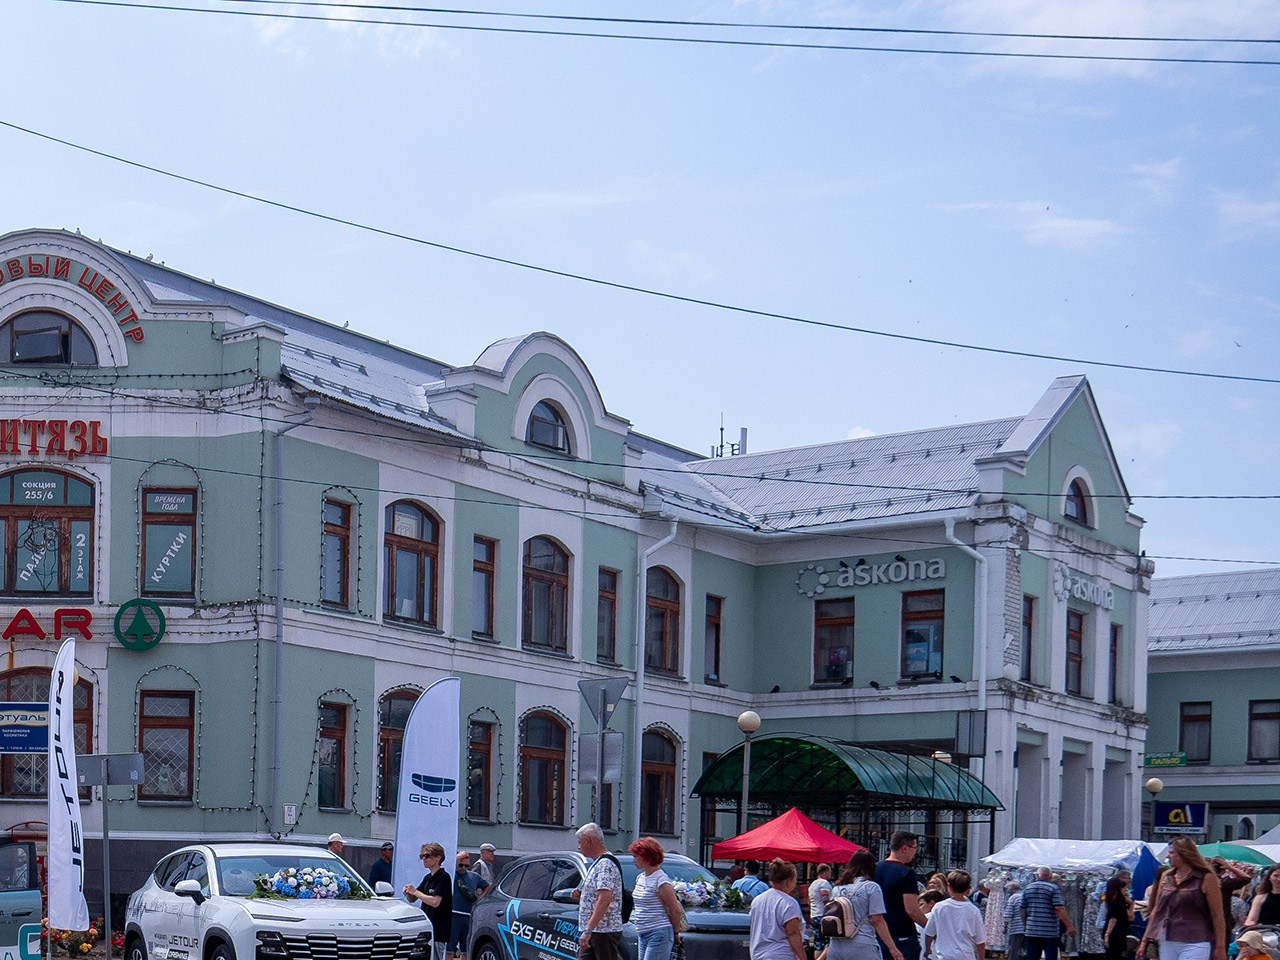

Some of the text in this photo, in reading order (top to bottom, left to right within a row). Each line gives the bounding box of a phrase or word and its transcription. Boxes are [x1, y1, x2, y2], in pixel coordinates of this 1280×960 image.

[77, 267, 145, 343] ЦЕНТР
[25, 491, 54, 500] 255/6
[161, 503, 178, 511] ГОДА
[76, 533, 86, 547] 2
[151, 532, 187, 582] КУРТКИ
[836, 557, 946, 588] askona
[1072, 575, 1115, 610] askona
[54, 671, 83, 893] JETOUR
[409, 793, 456, 808] GEELY
[169, 934, 199, 949] JETOUR
[510, 921, 581, 953] EX5 EM-i GEELY
